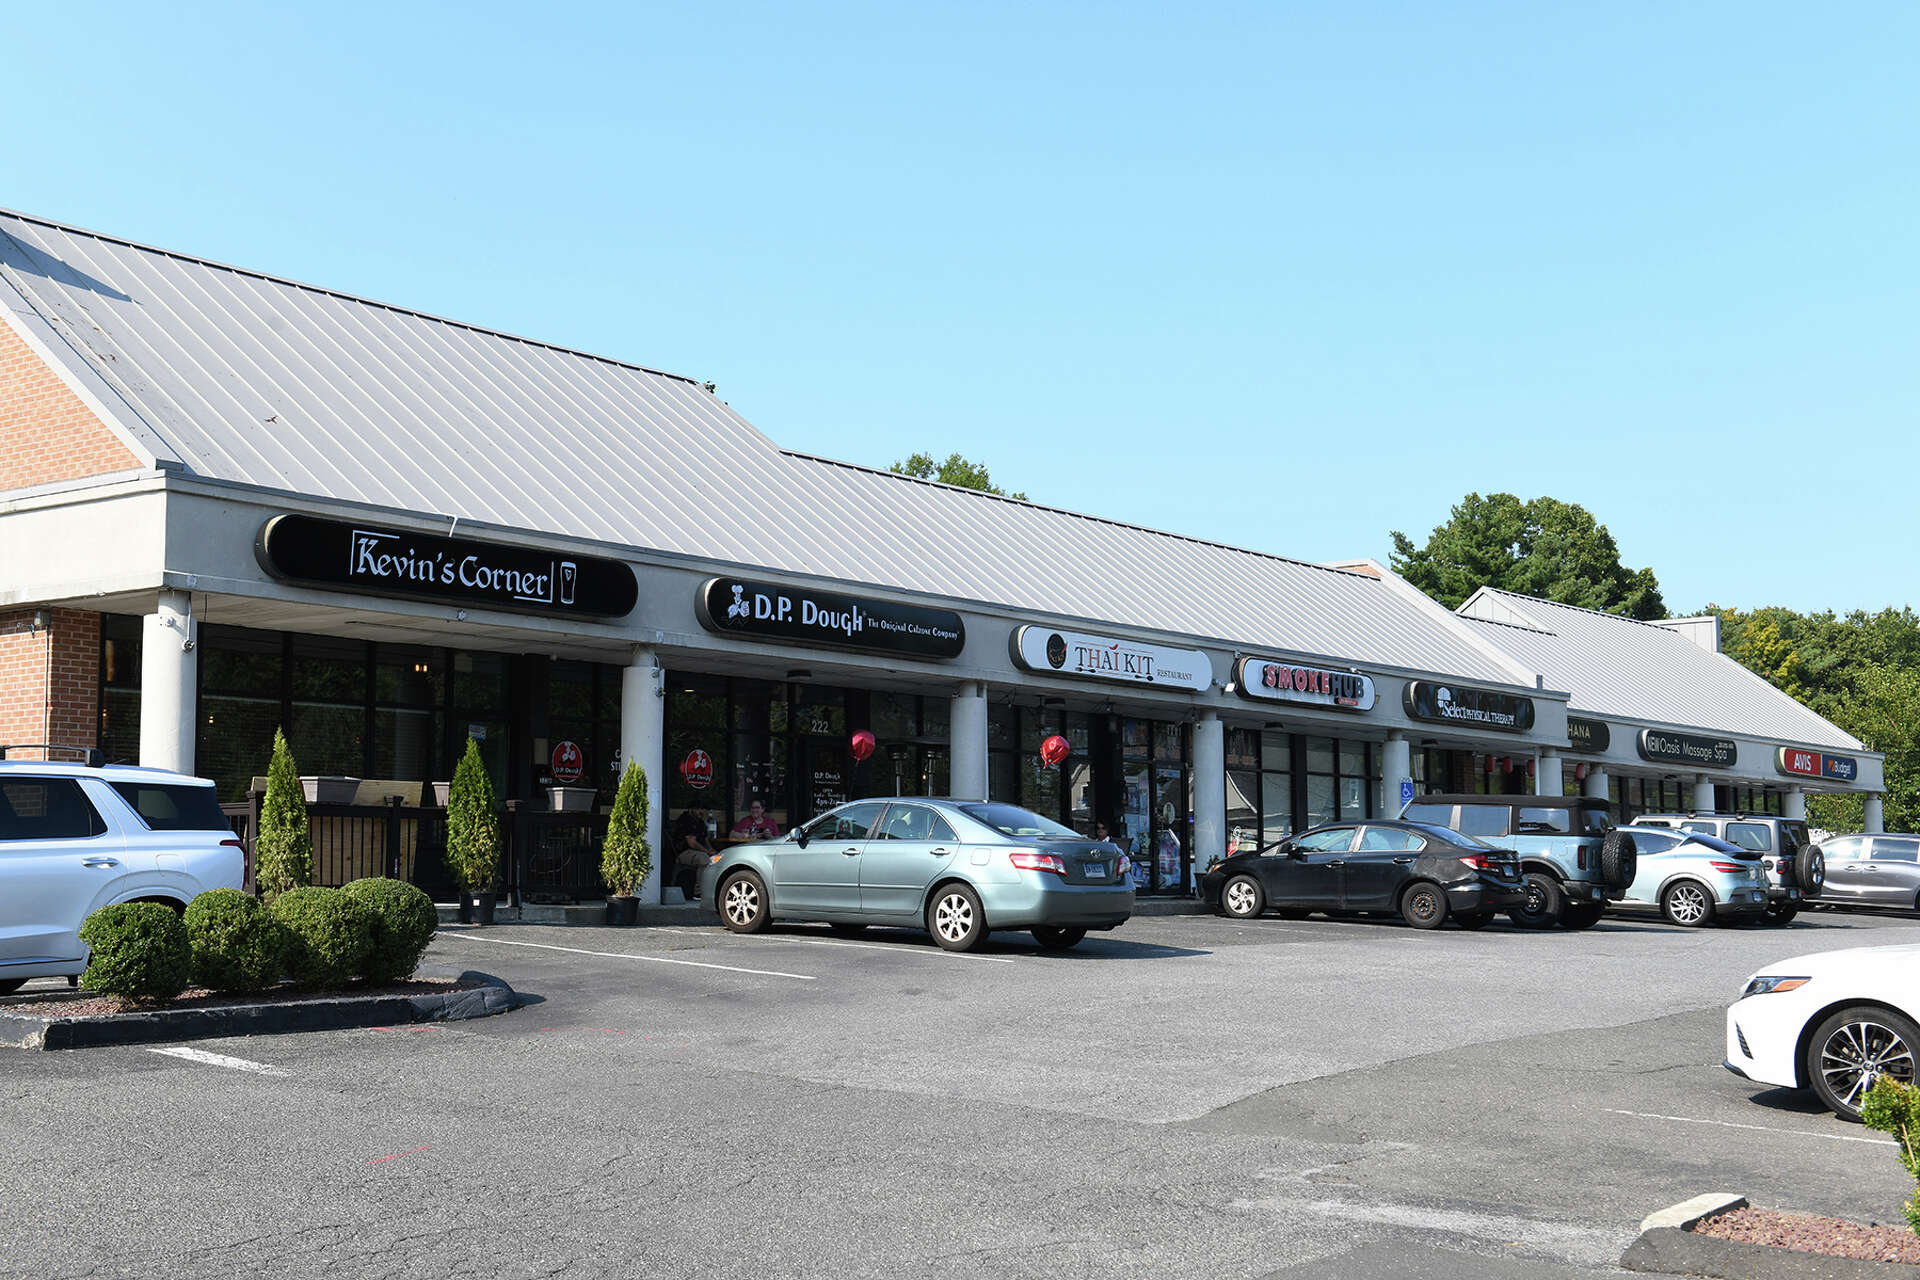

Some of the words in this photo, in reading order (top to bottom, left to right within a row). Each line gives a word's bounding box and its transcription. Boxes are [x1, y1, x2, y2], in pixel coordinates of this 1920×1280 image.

[356, 537, 455, 585] Kevin's
[458, 555, 549, 596] Corner
[754, 593, 793, 623] D.P.
[802, 599, 863, 637] Dough
[1075, 646, 1120, 672] THAI
[1124, 653, 1155, 675] KIT
[1156, 669, 1193, 682] RESTAURANT
[1264, 664, 1330, 694] SMOKE
[1443, 701, 1467, 719] Select
[1466, 709, 1491, 722] PHYSICAL
[1491, 712, 1515, 725] THERAPY
[811, 720, 829, 733] 222
[1660, 738, 1681, 754] Oasis
[1682, 741, 1713, 761] Massage
[1714, 744, 1728, 762] Spa
[1794, 753, 1812, 771] AVIS
[1834, 760, 1852, 777] Budget
